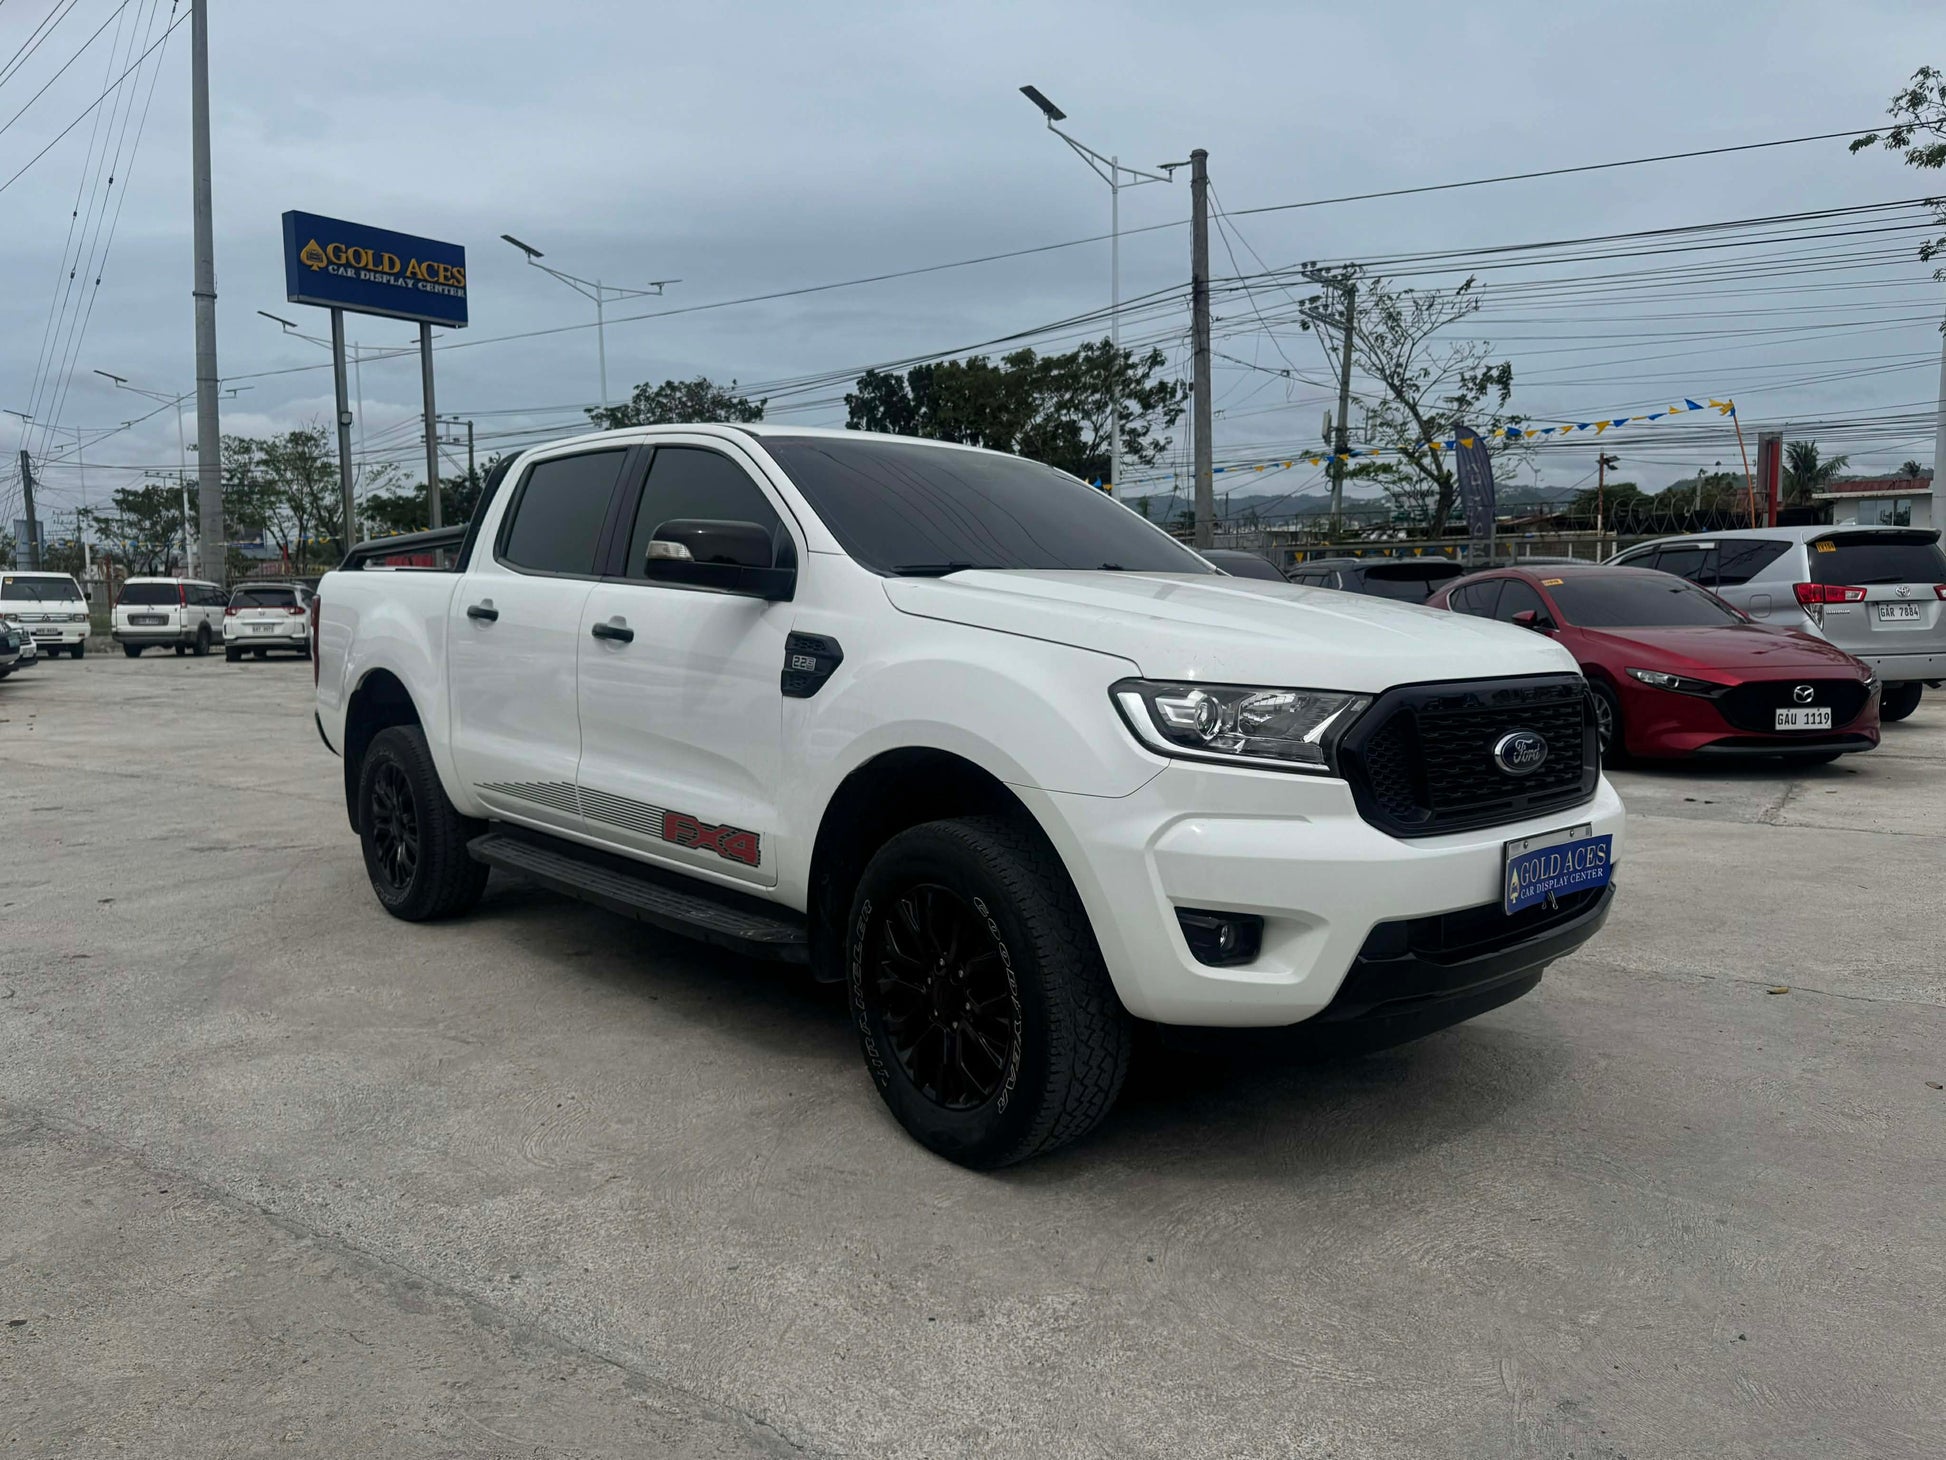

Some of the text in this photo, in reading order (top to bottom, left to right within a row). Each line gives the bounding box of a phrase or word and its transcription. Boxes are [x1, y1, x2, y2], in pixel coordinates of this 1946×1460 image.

[326, 243, 465, 287] GOLD ACES
[328, 264, 465, 297] CAR DISPLAY CENTER
[1880, 607, 1895, 617] GAR
[1777, 712, 1830, 725] GAU 1119
[1513, 739, 1541, 764] Ford
[662, 810, 761, 868] FX4
[1520, 843, 1606, 886] GOLD ACES
[1520, 868, 1604, 899] CAR DISPLAY CENTER
[973, 896, 1022, 1113] GOODYEAR
